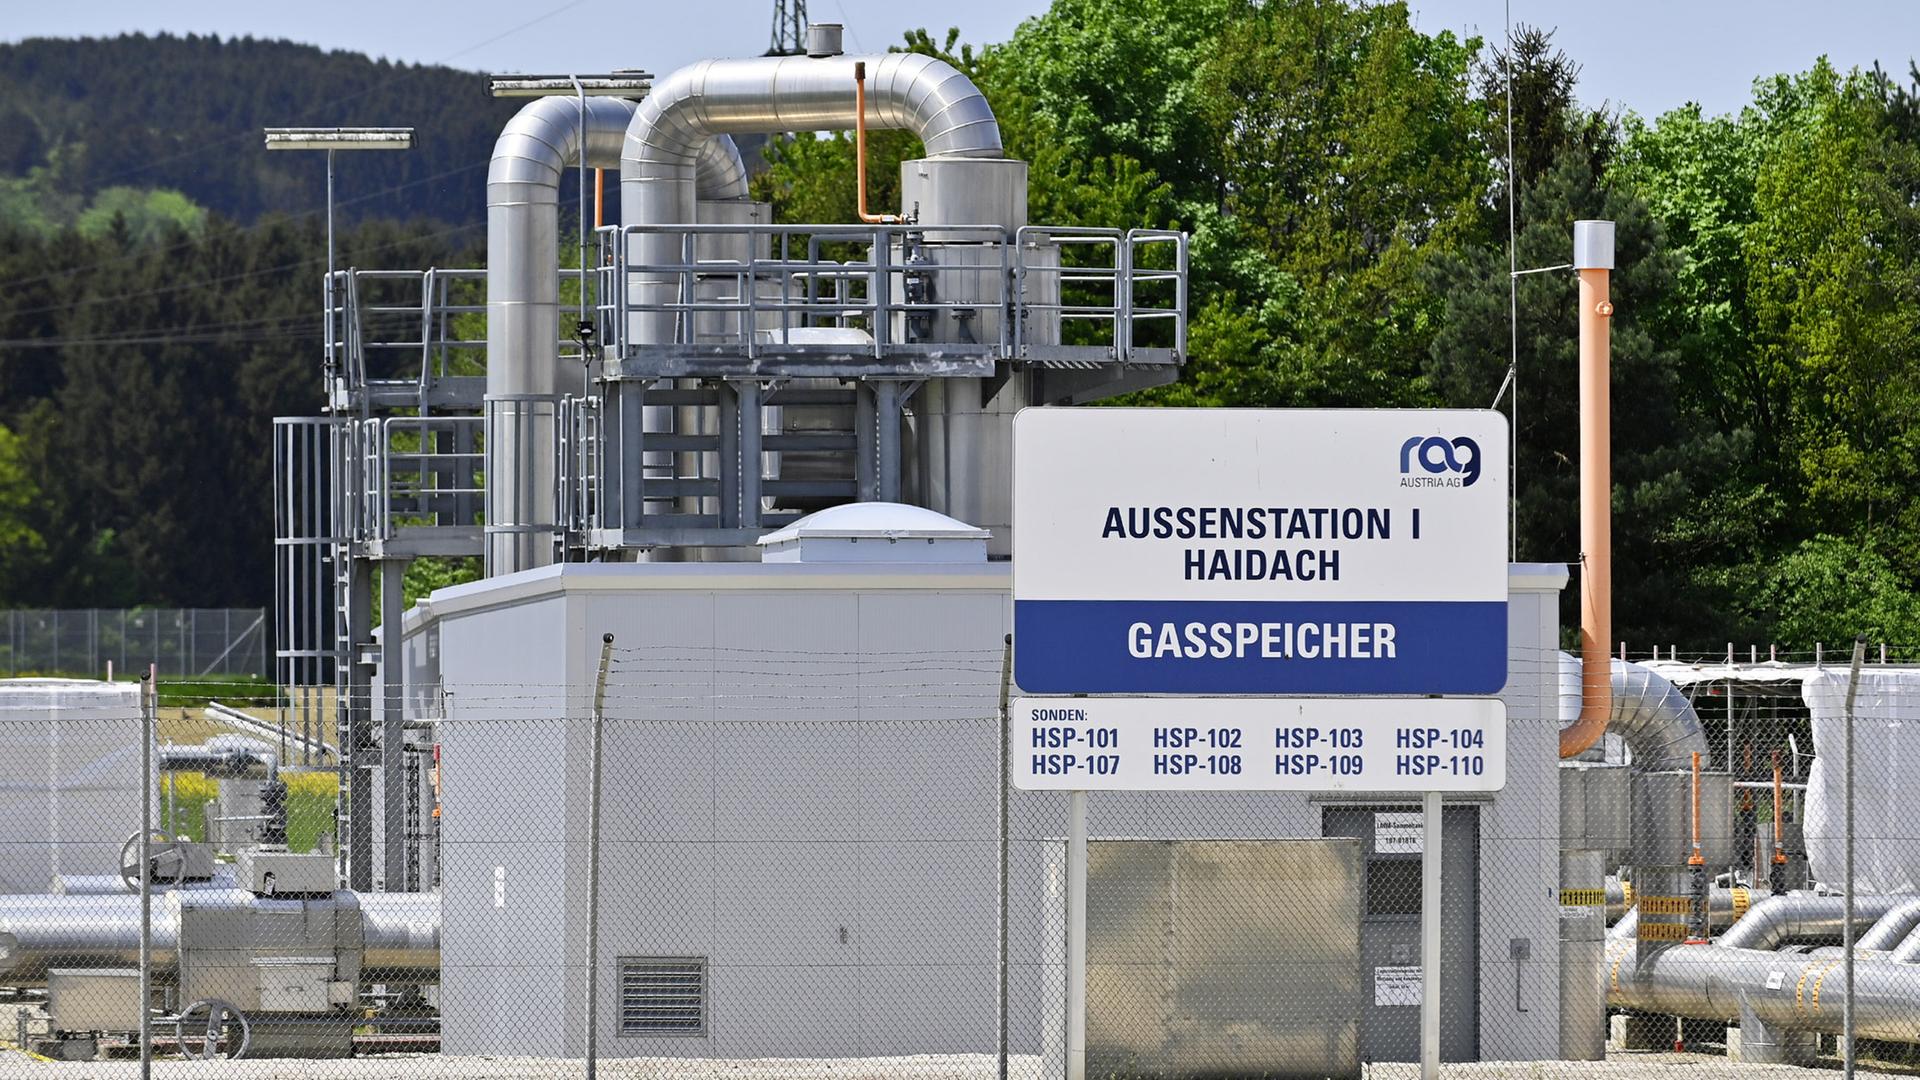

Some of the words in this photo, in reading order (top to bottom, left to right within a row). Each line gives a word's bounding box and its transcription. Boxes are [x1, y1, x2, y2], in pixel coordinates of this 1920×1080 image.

[1400, 436, 1482, 487] rag
[1400, 476, 1444, 488] AUSTRIA
[1446, 476, 1461, 488] AG
[1102, 507, 1391, 540] AUSSENSTATION
[1412, 508, 1420, 540] I
[1184, 549, 1340, 581] HAIDACH
[1128, 622, 1397, 658] GASSPEICHER
[1031, 709, 1088, 721] SONDEN:
[1032, 728, 1119, 749] HSP-101
[1153, 728, 1242, 749] HSP-102
[1275, 728, 1363, 749] HSP-103
[1396, 728, 1484, 749] HSP-104
[1032, 754, 1119, 775] HSP-107
[1153, 754, 1242, 775] HSP-108
[1275, 754, 1363, 775] HSP-109
[1396, 754, 1484, 775] HSP-110
